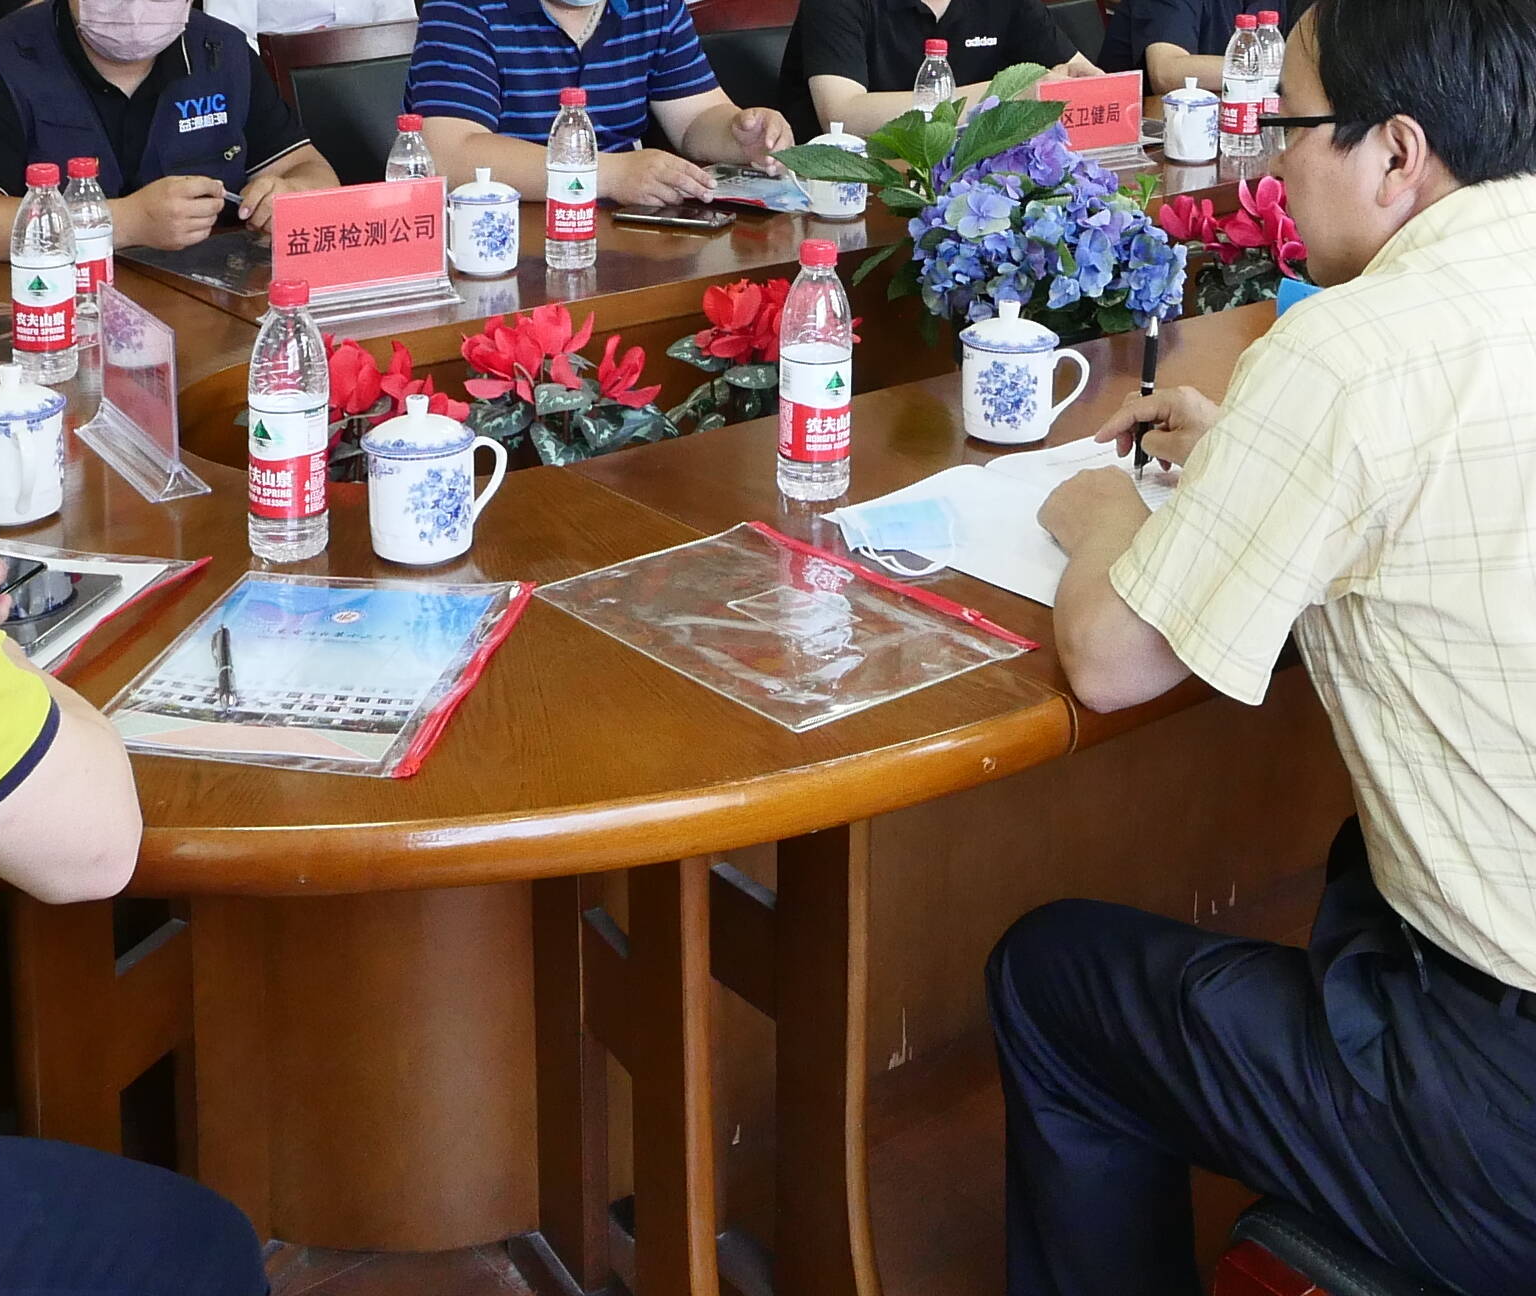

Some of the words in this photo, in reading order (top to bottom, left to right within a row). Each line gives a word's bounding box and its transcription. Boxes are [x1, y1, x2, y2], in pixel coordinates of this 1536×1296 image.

[965, 36, 998, 48] adidas
[175, 93, 226, 119] YYJC
[286, 213, 436, 256] 益源检测公司
